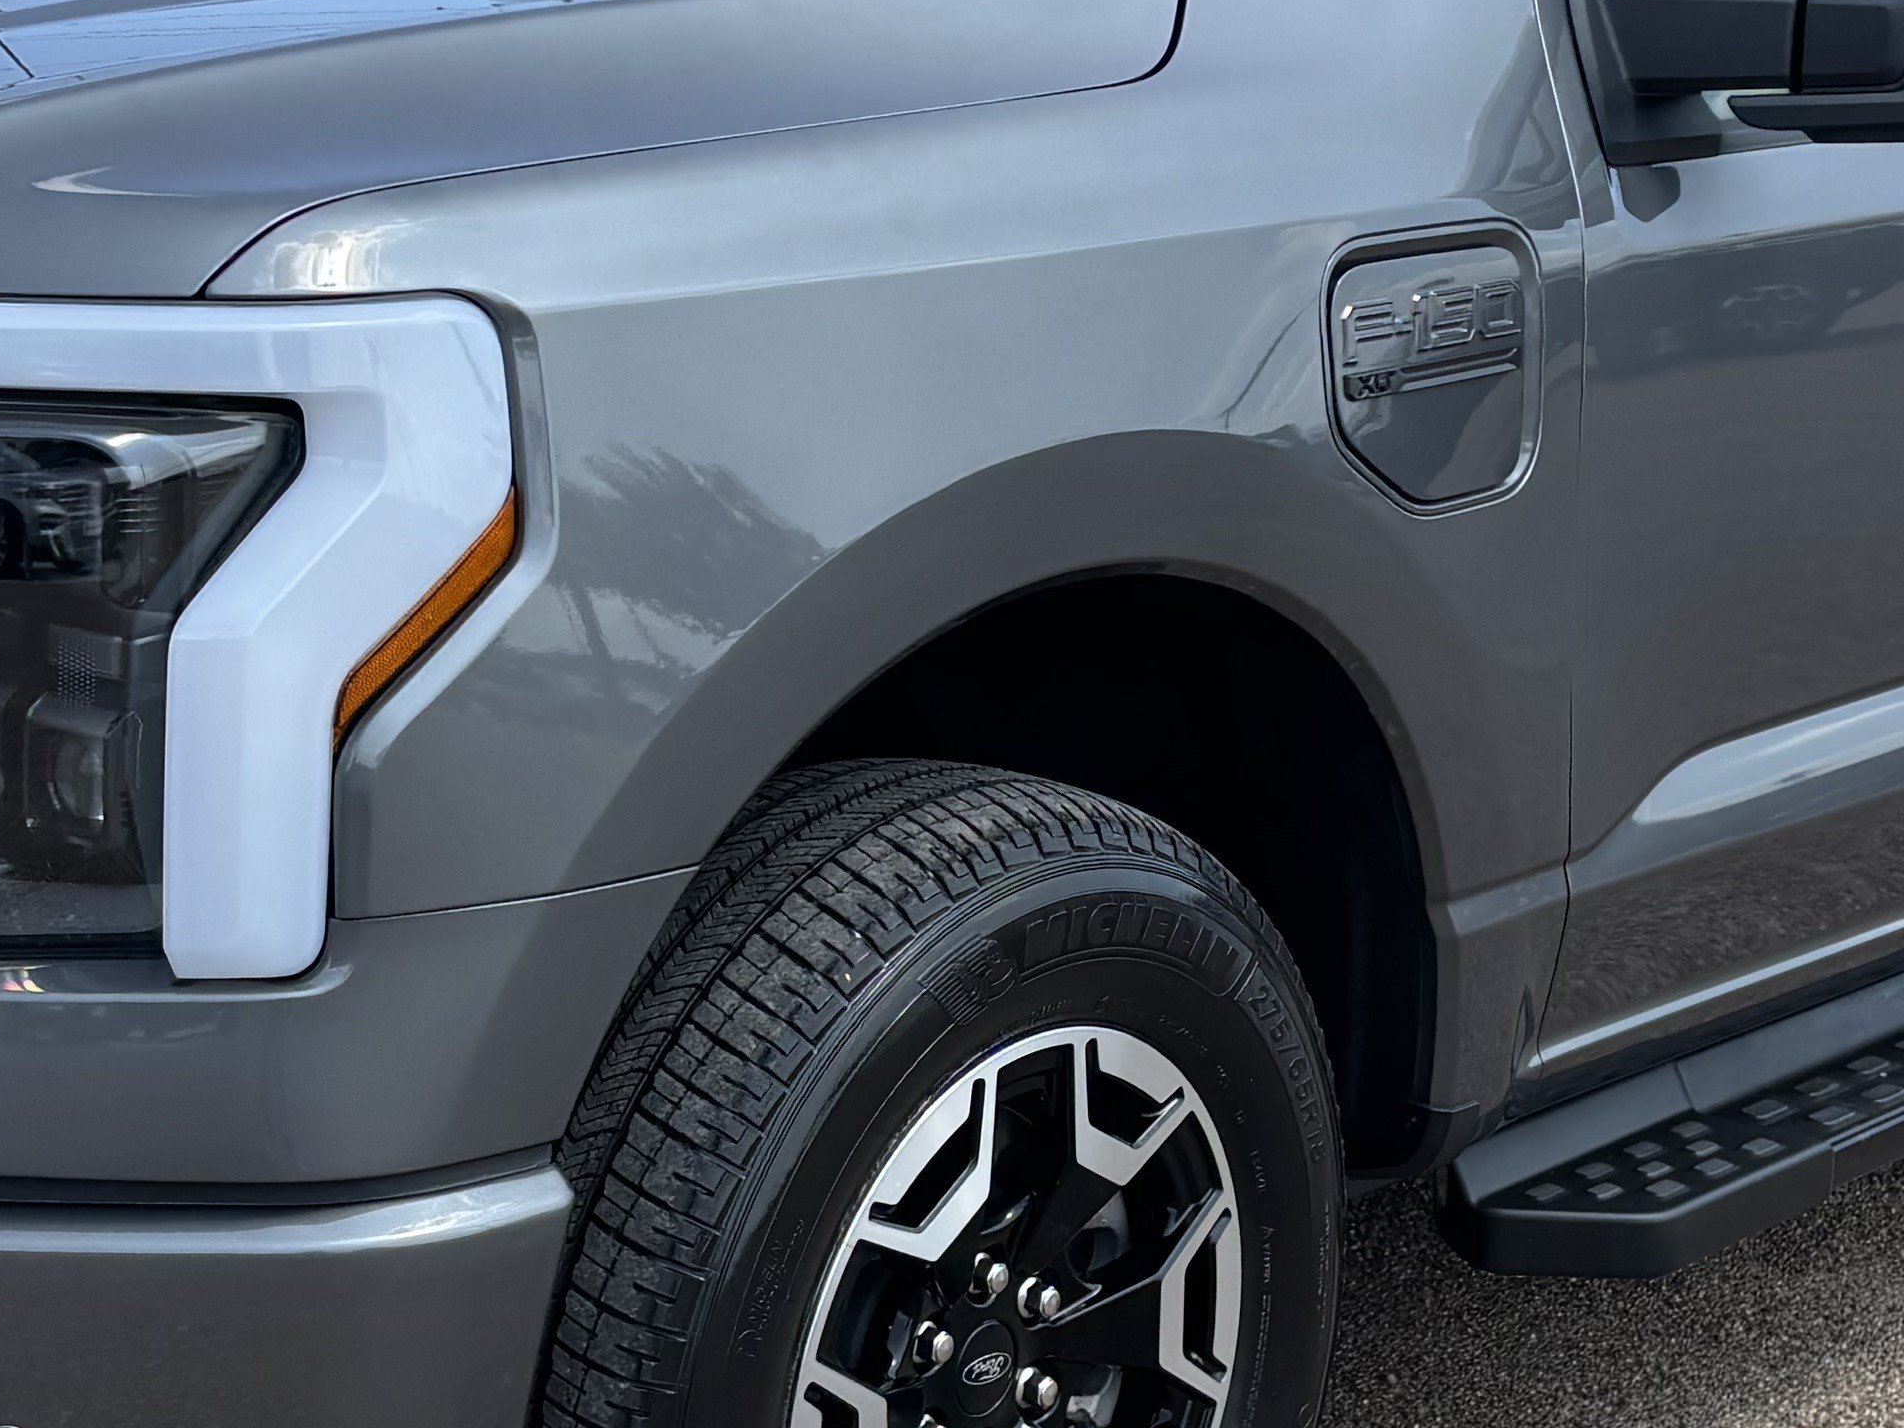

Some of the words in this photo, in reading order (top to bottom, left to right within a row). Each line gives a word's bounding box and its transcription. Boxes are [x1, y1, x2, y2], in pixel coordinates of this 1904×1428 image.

[1341, 277, 1523, 367] F-150
[1023, 902, 1239, 977] MICHELIN
[971, 1355, 1005, 1381] Ford
